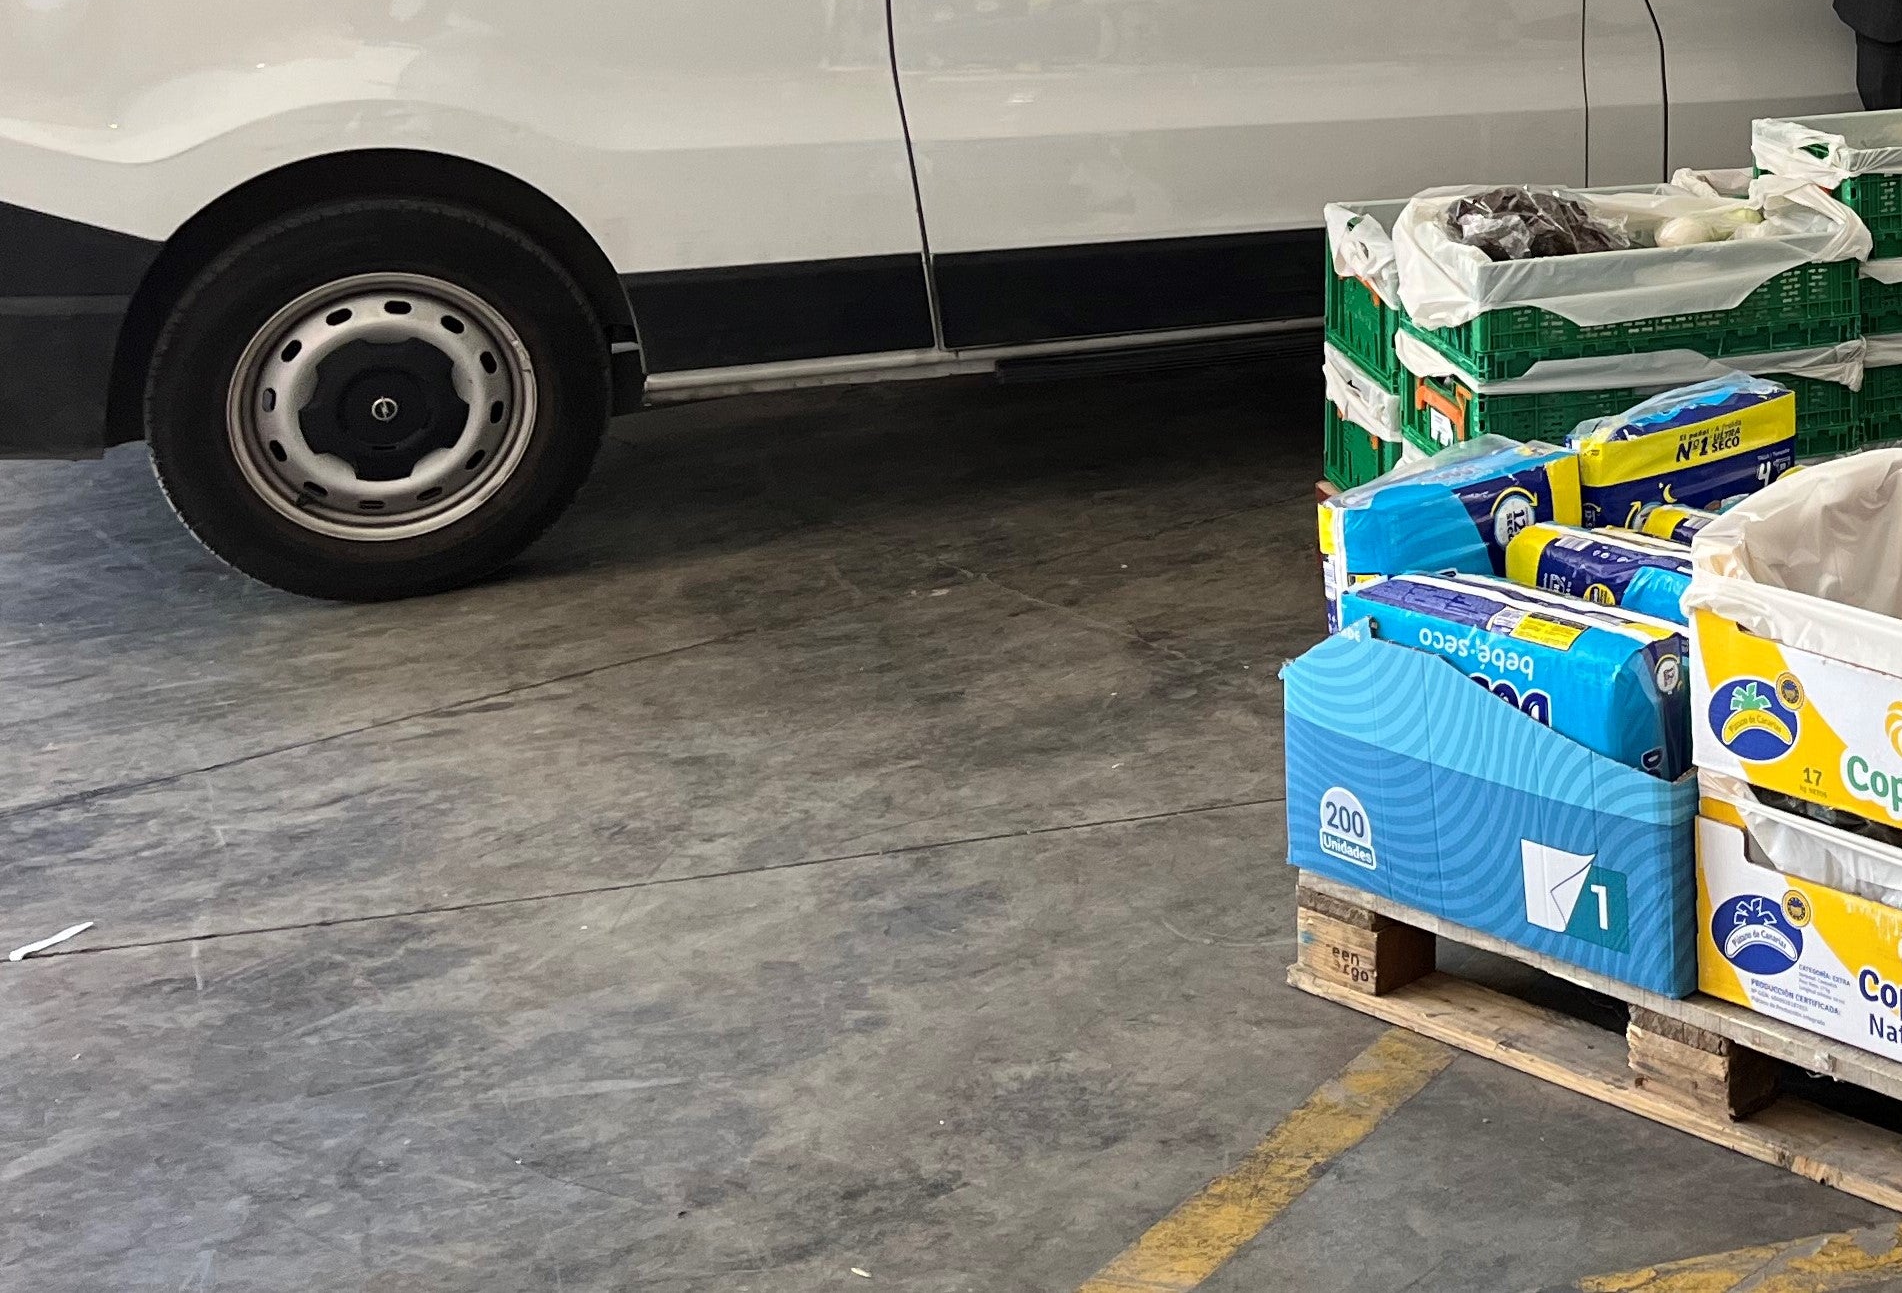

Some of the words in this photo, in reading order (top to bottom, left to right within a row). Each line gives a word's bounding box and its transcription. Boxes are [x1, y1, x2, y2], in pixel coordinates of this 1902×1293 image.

[1712, 436, 1740, 453] SECO
[1803, 767, 1823, 787] 17
[1325, 801, 1364, 838] 200
[1323, 832, 1373, 864] Unidades
[1590, 884, 1609, 930] 1
[1751, 979, 1794, 999] PRODUCCIÓN
